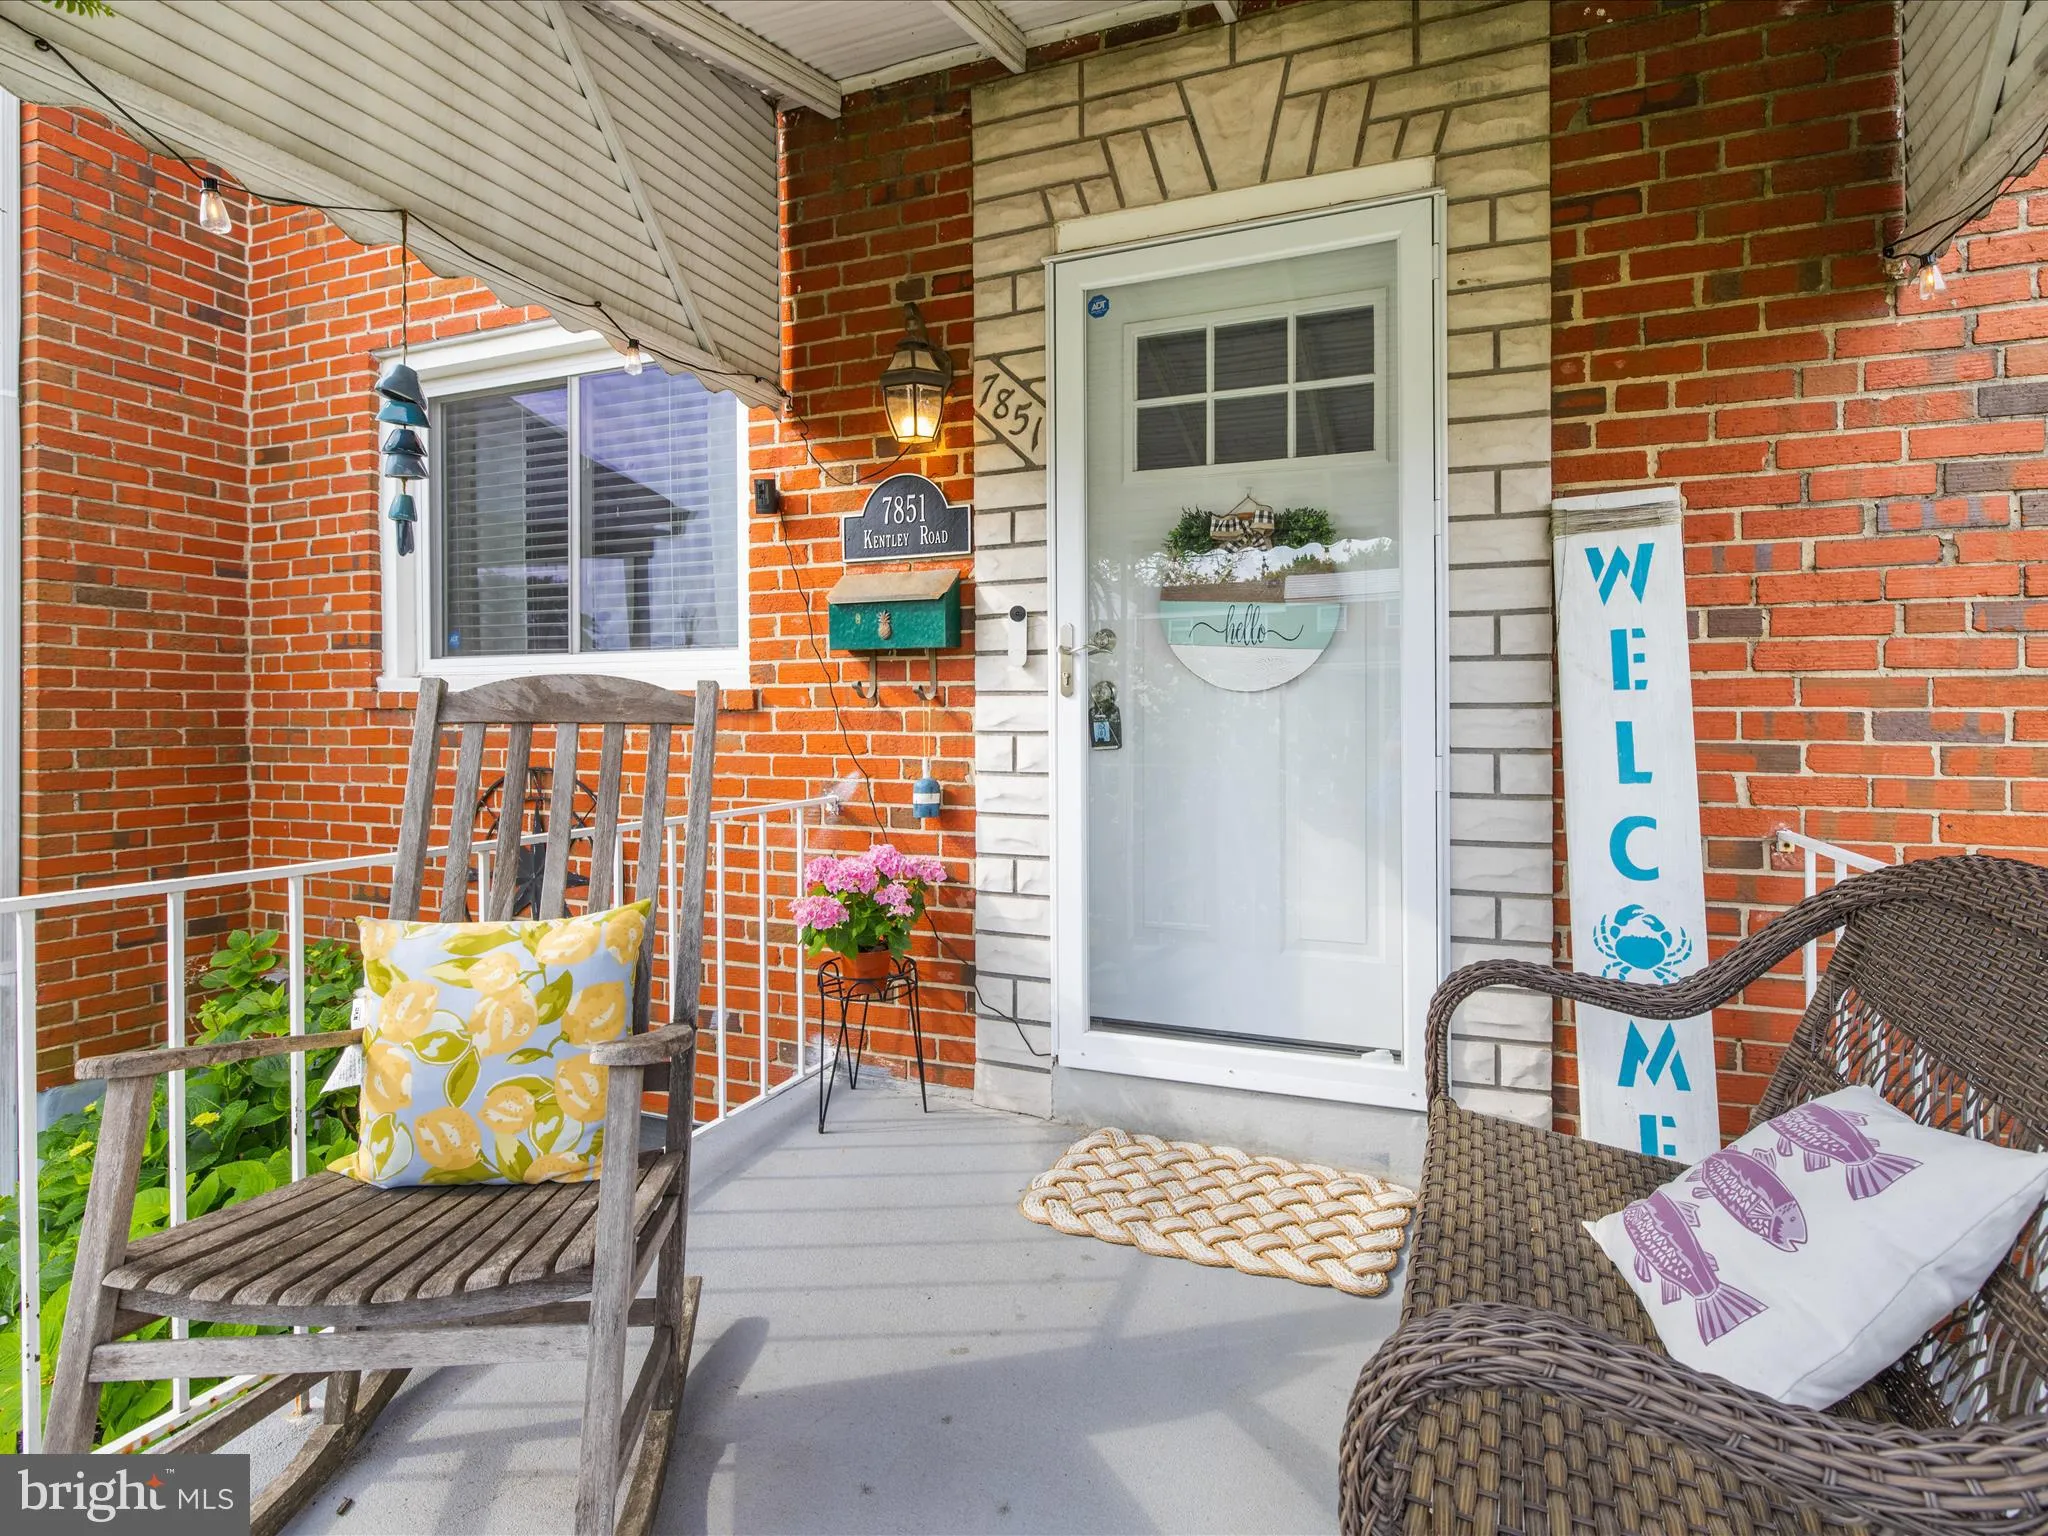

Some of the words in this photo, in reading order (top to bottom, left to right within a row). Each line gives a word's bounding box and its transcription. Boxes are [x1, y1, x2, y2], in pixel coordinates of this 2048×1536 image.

[1091, 300, 1106, 310] ADT
[979, 373, 1042, 452] 7851
[882, 493, 926, 525] 7851
[863, 529, 909, 549] KENTLEY
[919, 525, 949, 545] ROAD
